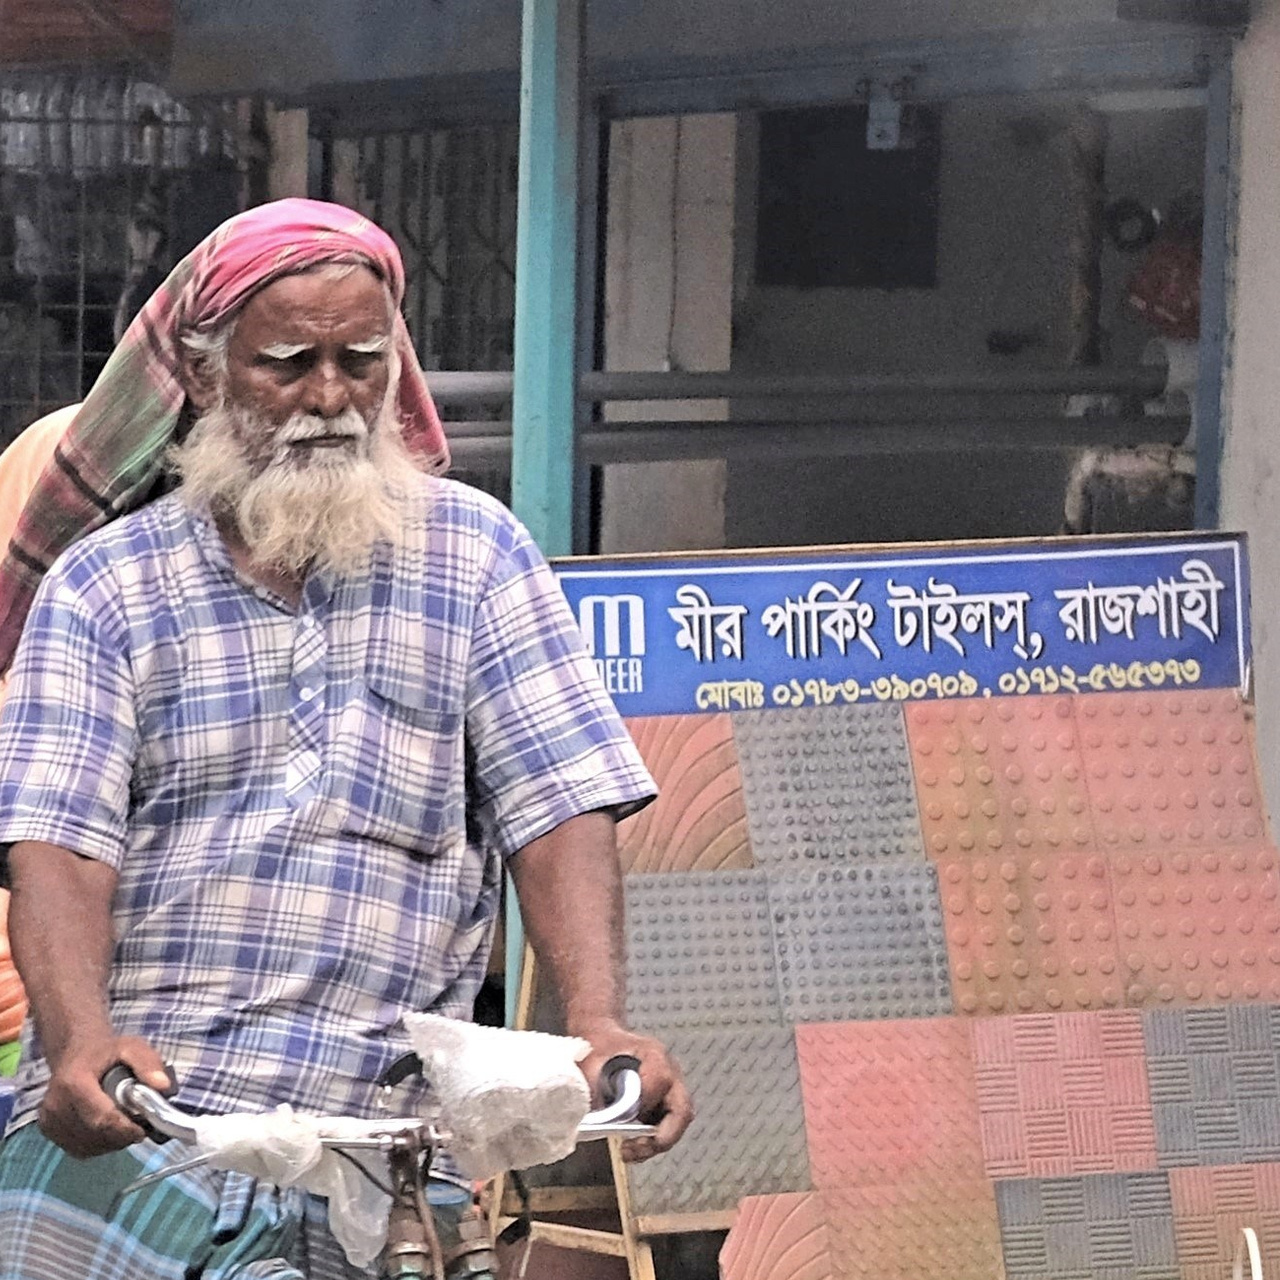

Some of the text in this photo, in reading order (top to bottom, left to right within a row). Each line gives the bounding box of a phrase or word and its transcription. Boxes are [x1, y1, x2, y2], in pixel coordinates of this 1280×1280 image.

[667, 559, 1225, 662] মীর পার্কিং টাইলস্, রাজশাহী
